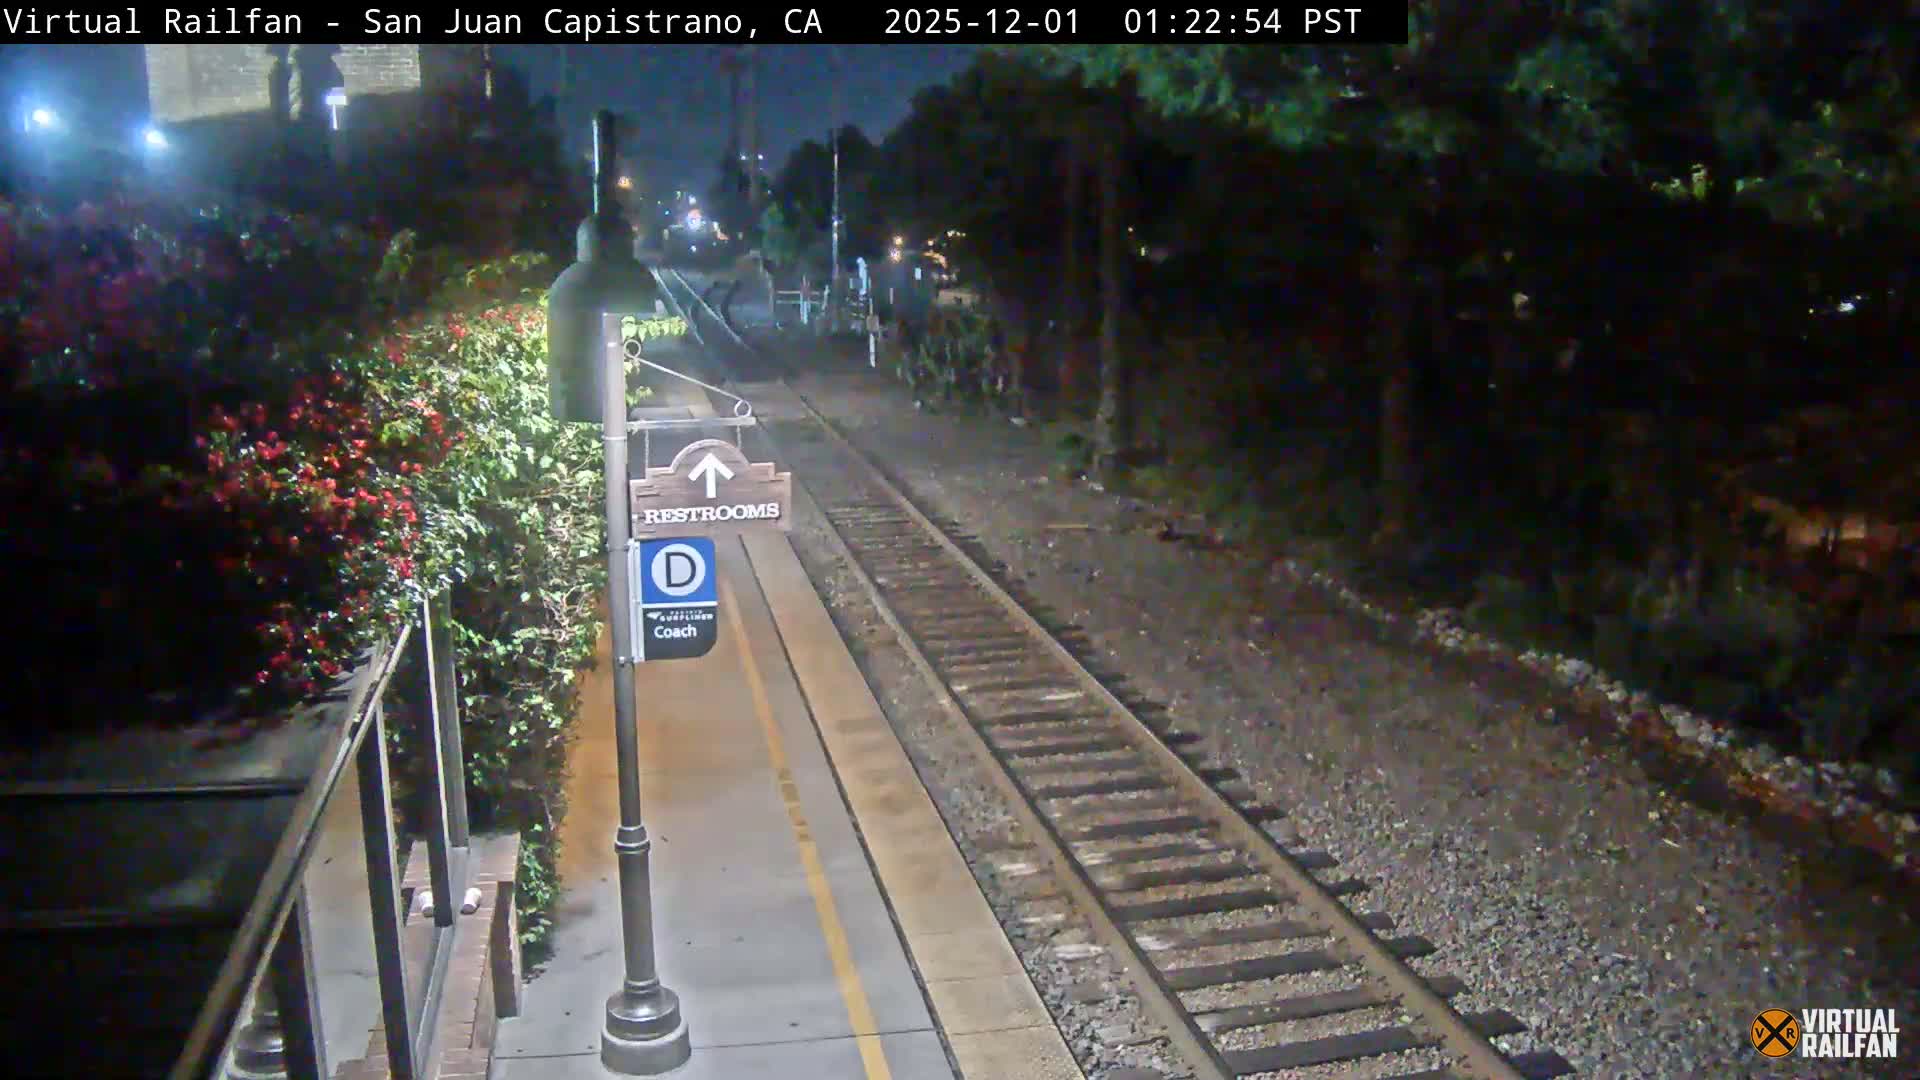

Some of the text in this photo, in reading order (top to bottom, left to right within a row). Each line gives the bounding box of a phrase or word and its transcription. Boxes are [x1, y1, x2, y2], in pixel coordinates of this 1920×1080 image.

[644, 503, 779, 524] RESTROOMS
[665, 552, 696, 587] D
[654, 624, 697, 638] Coach
